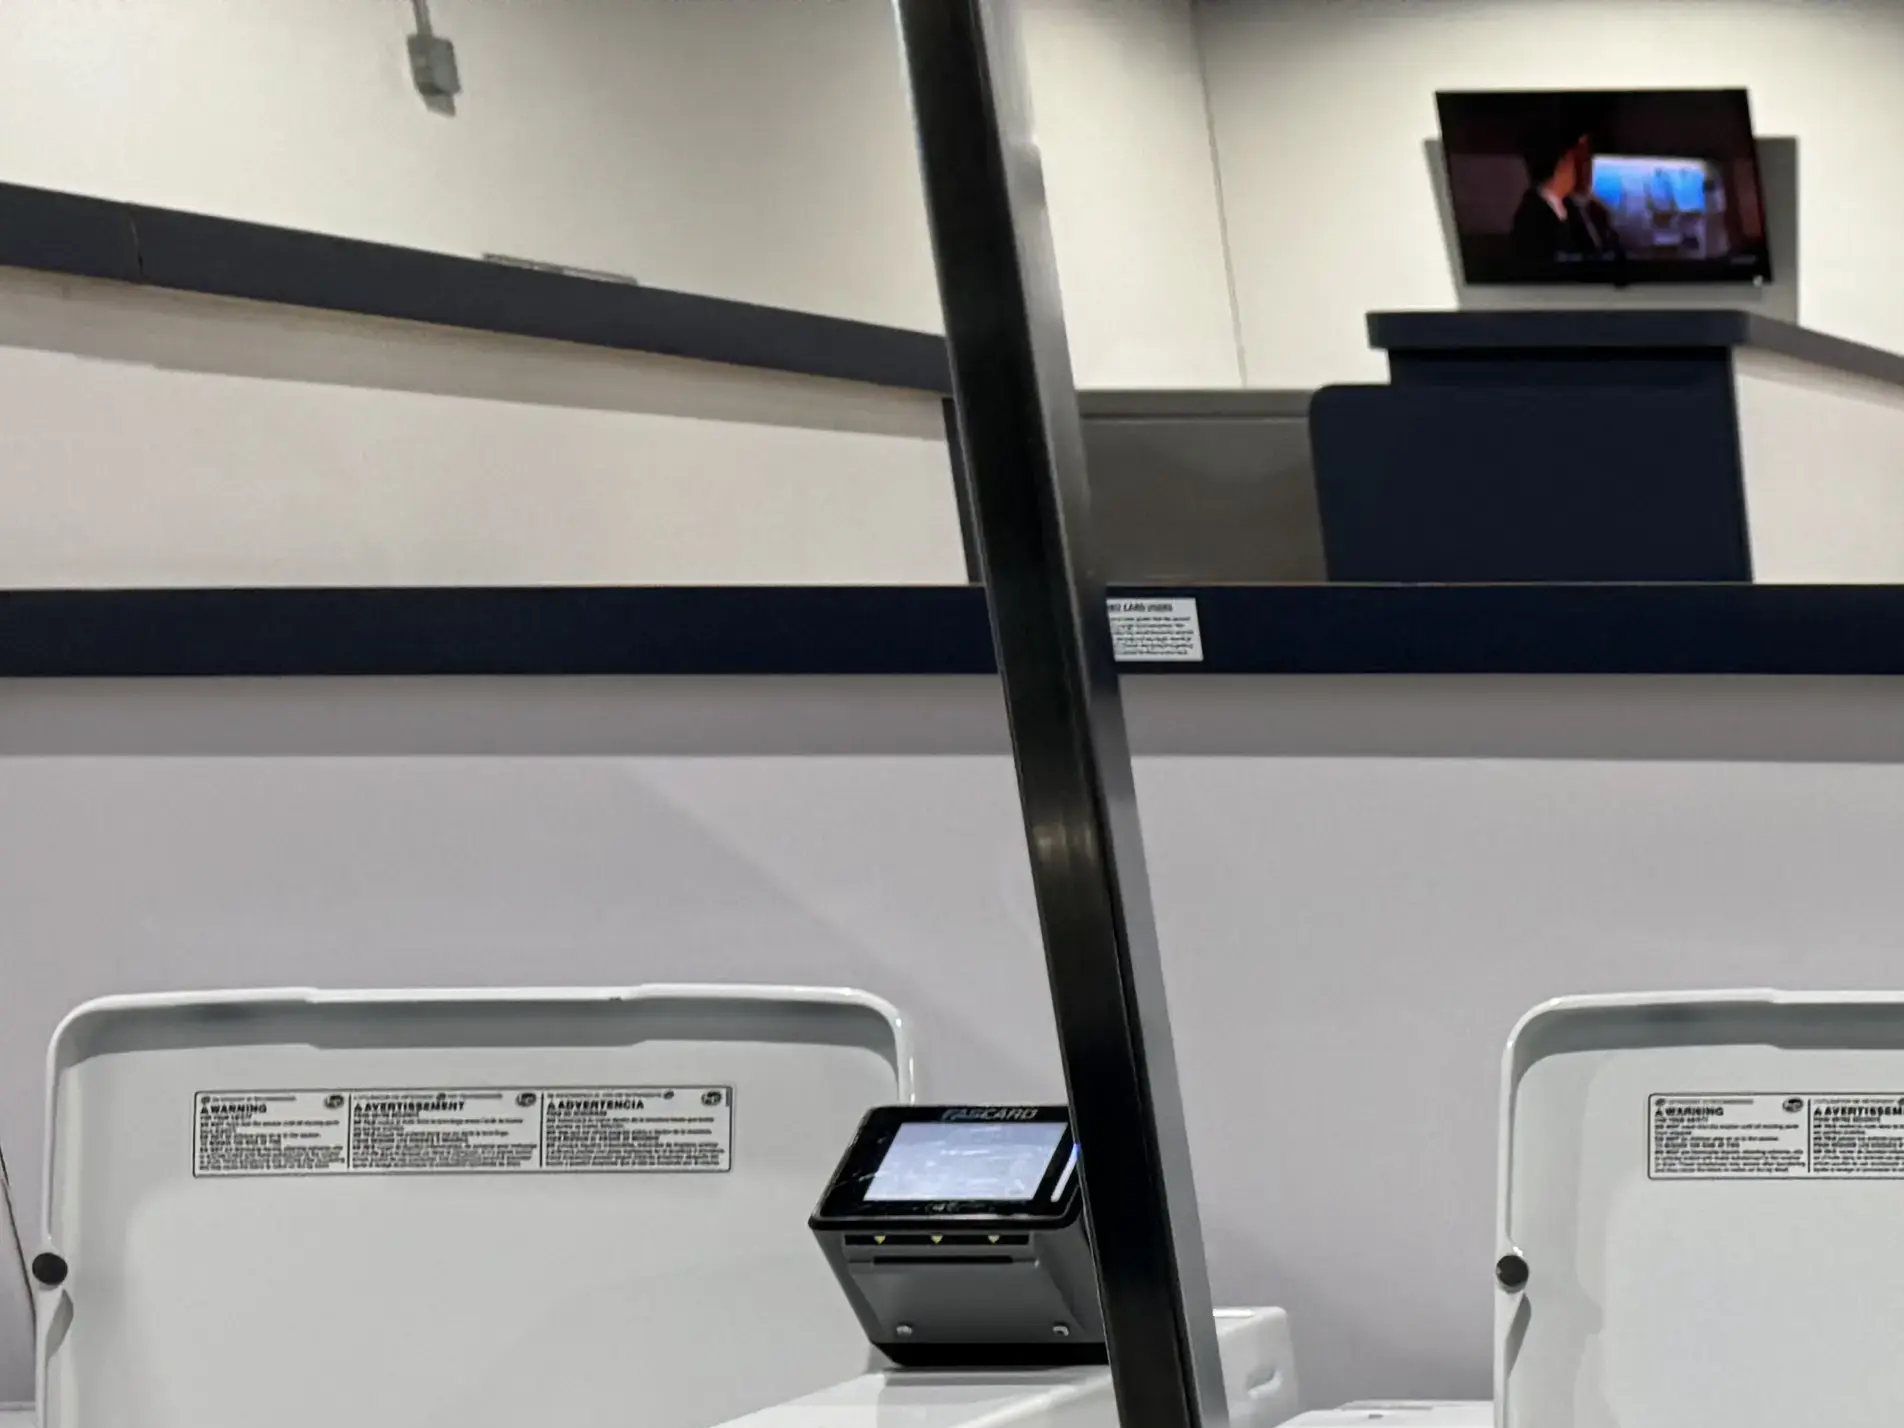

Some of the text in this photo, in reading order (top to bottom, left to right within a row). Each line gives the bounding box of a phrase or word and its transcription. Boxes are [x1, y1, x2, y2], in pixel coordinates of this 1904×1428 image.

[211, 1104, 267, 1114] WARNING
[365, 1101, 465, 1112] AVERTISSEMENT
[558, 1100, 644, 1110] ADVERTENCIA
[940, 1108, 1038, 1121] FASCARD
[1665, 1107, 1724, 1117] WARNING
